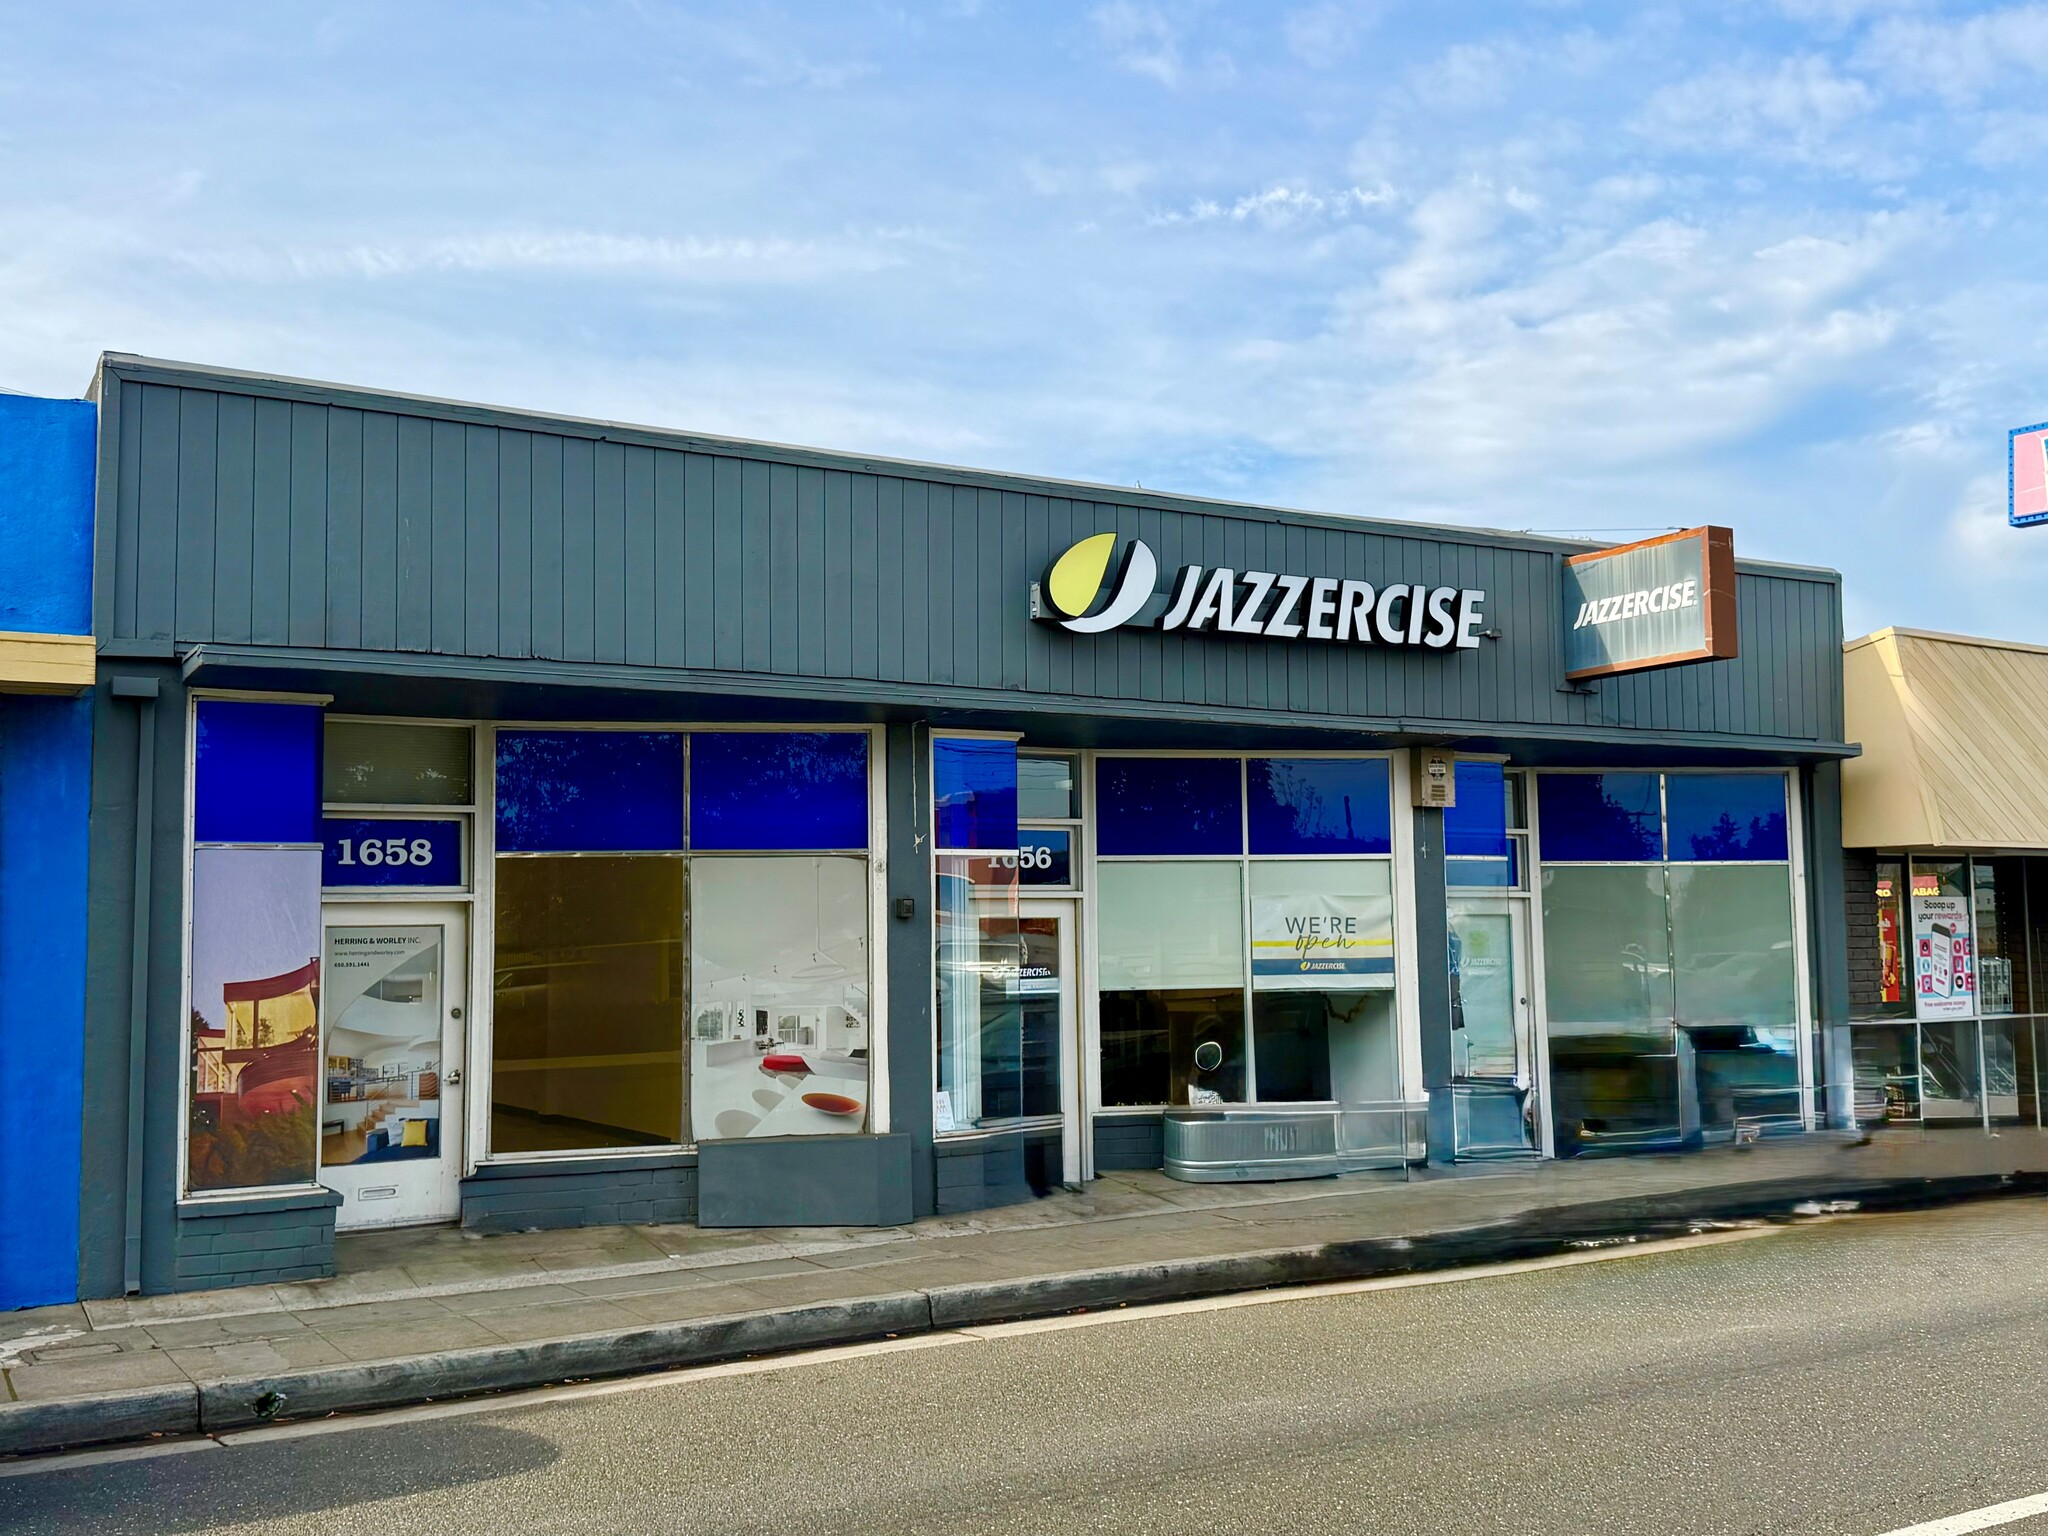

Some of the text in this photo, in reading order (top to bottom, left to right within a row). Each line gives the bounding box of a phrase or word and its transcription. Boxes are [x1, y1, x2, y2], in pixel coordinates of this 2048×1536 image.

[1162, 564, 1486, 649] JAZZERCISE
[338, 838, 433, 866] 1658
[1923, 899, 1956, 910] Scoop up
[1917, 910, 1963, 923] your rewards
[1285, 916, 1357, 934] WE'RE
[376, 937, 407, 945] WORLEY
[1295, 933, 1356, 961] open
[1310, 962, 1346, 970] JAZZERCISE
